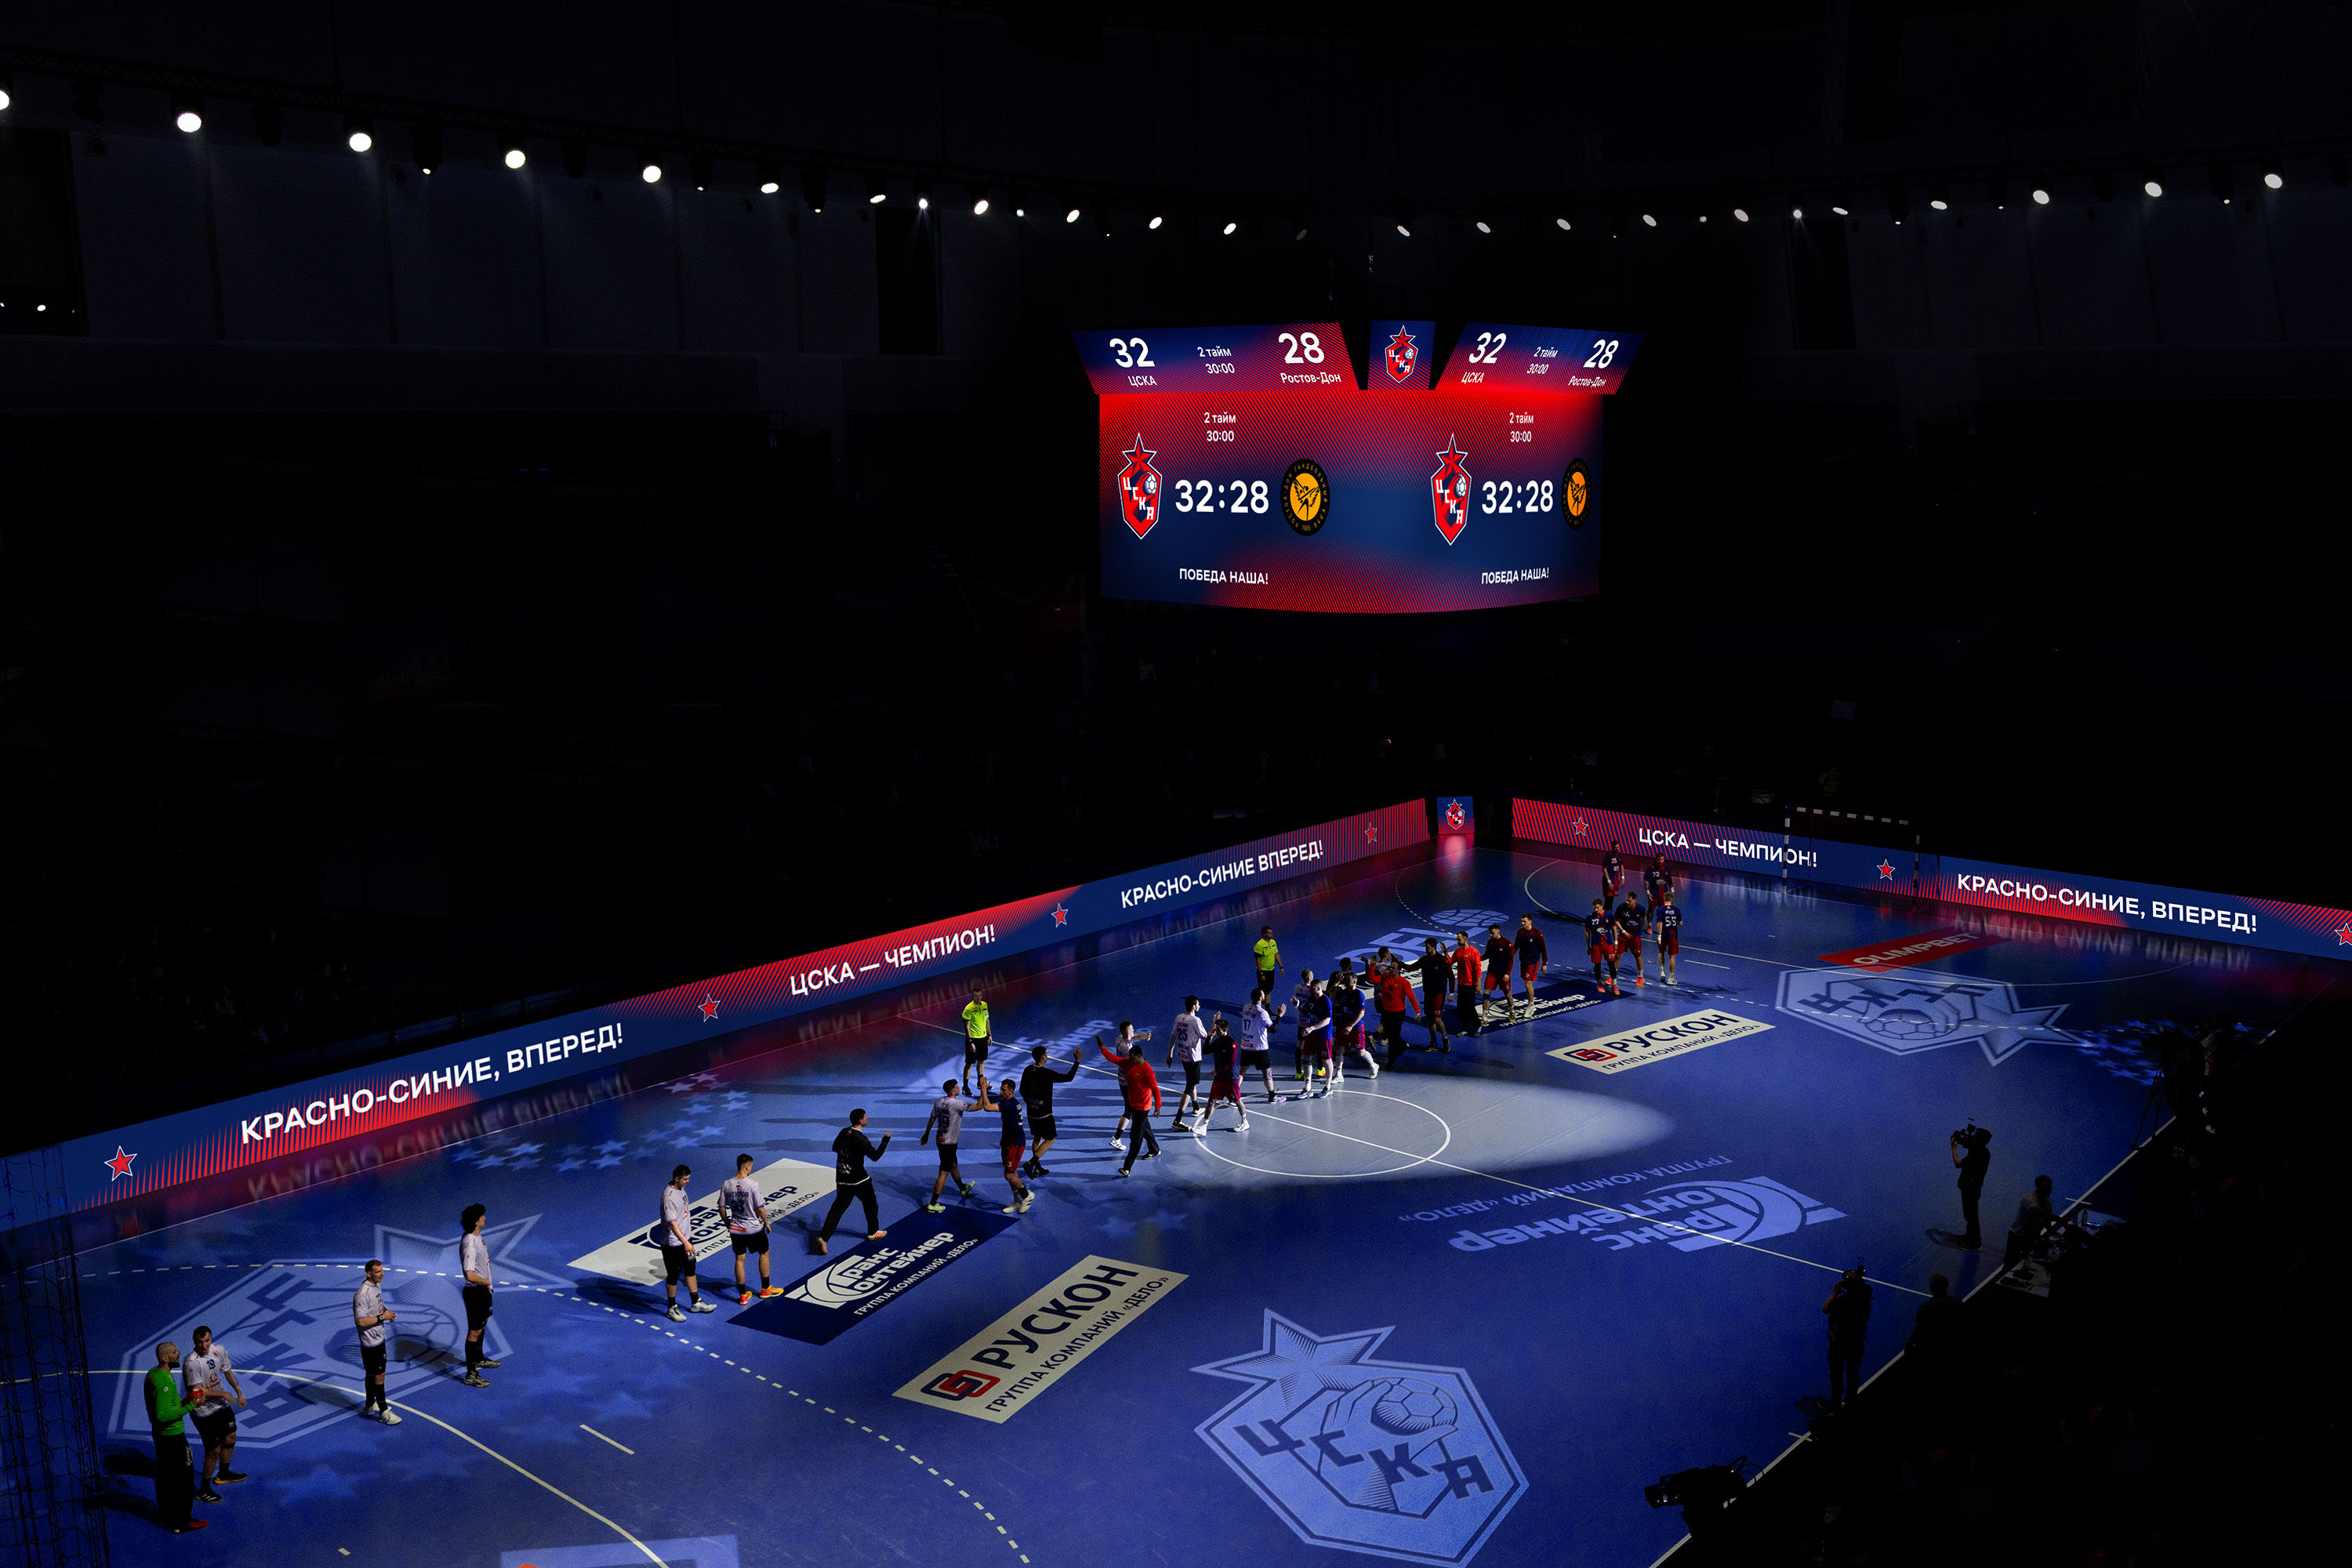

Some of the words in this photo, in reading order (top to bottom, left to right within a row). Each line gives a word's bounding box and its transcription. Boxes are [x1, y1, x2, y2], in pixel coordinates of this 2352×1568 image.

[1109, 337, 1156, 368] 32
[1197, 347, 1205, 358] 2
[1206, 345, 1232, 358] тайм
[1278, 332, 1325, 364] 28
[1388, 350, 1410, 373] ЦСКА
[1468, 332, 1507, 364] 32
[1534, 347, 1540, 358] 2
[1541, 347, 1558, 358] тайм
[1583, 339, 1619, 368] 28
[1127, 376, 1158, 388] ЦСКА
[1205, 363, 1236, 375] 30:00
[1280, 372, 1341, 383] Ростов-Дон
[1461, 372, 1485, 384] ЦСКА
[1526, 364, 1549, 375] 30:00
[1568, 376, 1606, 387] Ростов-Дон
[1204, 412, 1210, 424] 2
[1211, 412, 1236, 424] тайм
[1509, 412, 1515, 424] 2
[1515, 412, 1534, 424] тайм
[1207, 430, 1235, 442] 30:00
[1510, 430, 1532, 442] 30:00
[1123, 477, 1155, 521] ЦСКА
[1175, 479, 1269, 514] 32:28
[1436, 479, 1464, 524] ЦСКА
[1481, 480, 1553, 514] 32:28
[1179, 568, 1226, 583] ПОБЕДА
[1229, 571, 1269, 585] НАША!
[1481, 571, 1519, 584] ПОБЕДА
[1521, 567, 1549, 581] НАША!
[1639, 827, 1689, 850] ЦСКА
[1715, 838, 1817, 868] ЧЕМПИОН!
[1121, 858, 1254, 909] КРАСНО-СИНИЕ
[1258, 840, 1323, 872] ВПЕРЕД!
[1957, 873, 2146, 920] КРАСНО-СИНИЕ,
[2152, 901, 2257, 934] ВПЕРЕД!
[1665, 916, 1677, 927] 55
[790, 961, 855, 996] ЦСКА
[884, 924, 996, 967] ЧЕМПИОН!
[1853, 931, 1980, 965] OLIMPBET
[1177, 1027, 1188, 1042] 25
[1243, 1019, 1251, 1032] 17
[1602, 1014, 1740, 1053] РУСКОН
[1602, 1054, 1650, 1070] ГРУППА
[1648, 1035, 1715, 1058] КОМПАНИЙ
[1719, 1025, 1760, 1039] «ДЕЛО»
[241, 1056, 501, 1145] КРАСНО-СИНИЕ,
[506, 1022, 624, 1074] ВПЕРЕД!
[1644, 1155, 1734, 1178] ГРУППА
[1502, 1171, 1646, 1207] КОМПАНИЙ
[854, 1290, 895, 1316] ГРУППА
[891, 1258, 947, 1292] КОМПАНИЙ
[946, 1239, 978, 1259] «ДЕЛО»
[970, 1265, 1140, 1370] РУСКОН
[985, 1370, 1049, 1412] ГРУППА
[1040, 1309, 1126, 1370] КОМПАНИЙ
[1122, 1277, 1169, 1311] «ДЕЛО»
[206, 1359, 216, 1370] 19
[1232, 1418, 1495, 1500] ЦСКА
